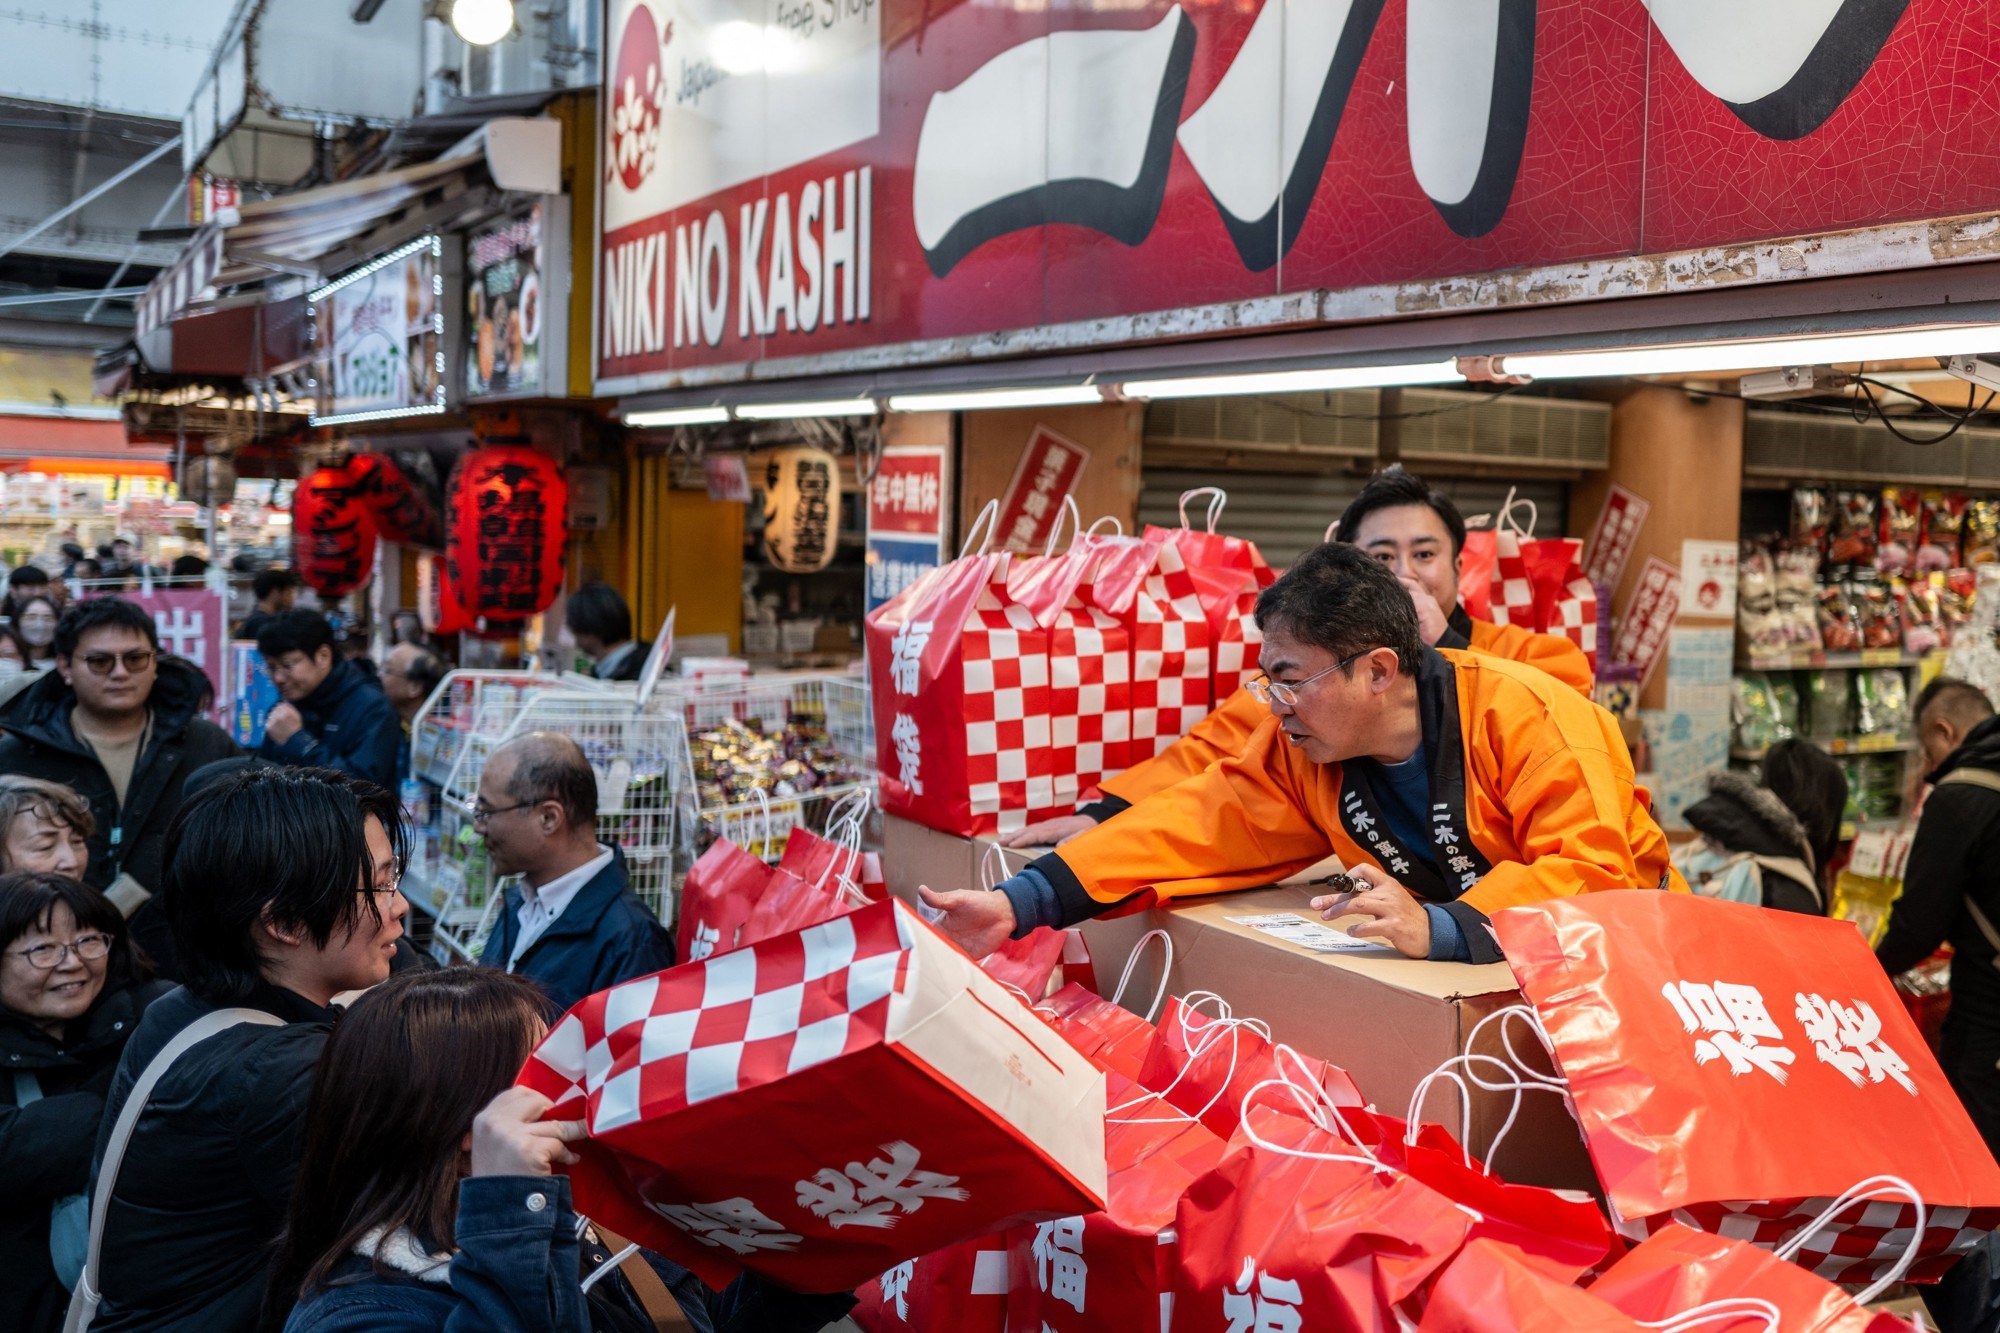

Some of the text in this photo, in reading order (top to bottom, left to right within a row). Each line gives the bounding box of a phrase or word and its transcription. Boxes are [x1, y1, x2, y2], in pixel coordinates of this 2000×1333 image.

[603, 231, 667, 360] NIKI
[673, 209, 729, 348] NO
[739, 165, 872, 338] KASHI
[889, 620, 934, 797] 福袋
[1344, 790, 1410, 875] 二木の菓子
[1661, 979, 1919, 1098] 福袋
[643, 1139, 971, 1256] 福袋
[1031, 1214, 1089, 1333] 福
